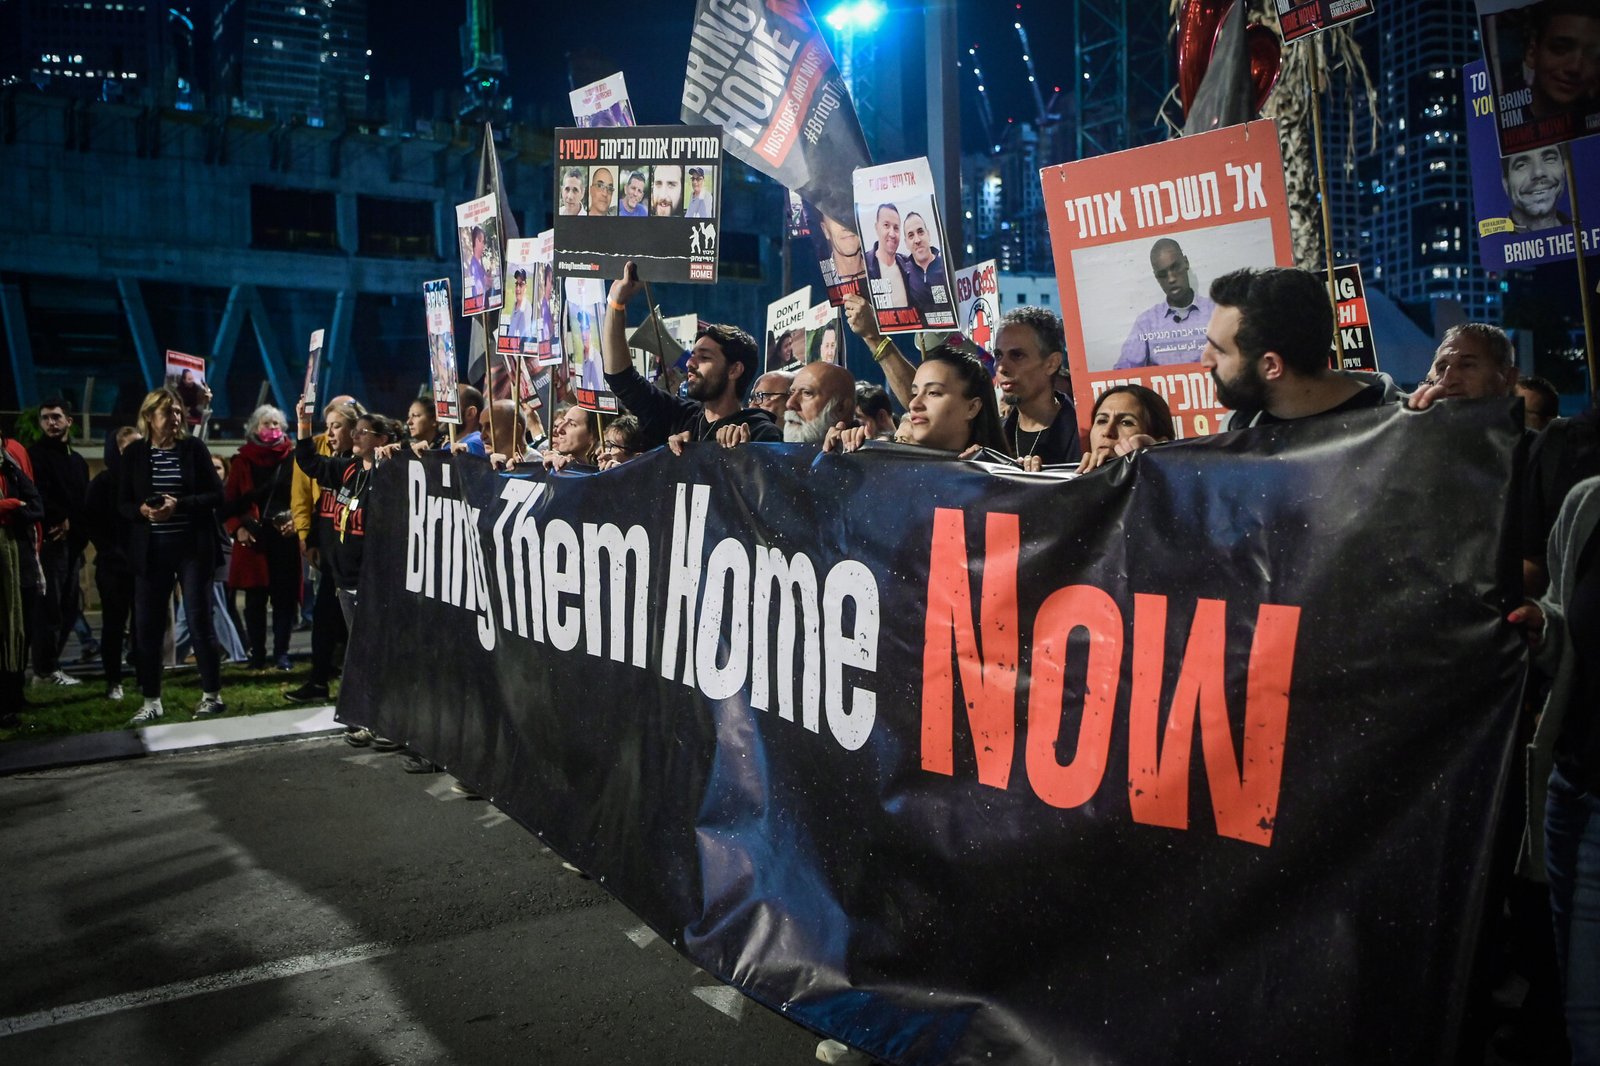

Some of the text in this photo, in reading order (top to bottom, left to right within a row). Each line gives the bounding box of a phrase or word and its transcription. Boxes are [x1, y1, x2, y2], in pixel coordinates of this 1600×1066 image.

[682, 0, 757, 114] BRING
[702, 17, 800, 148] HOME
[1470, 71, 1486, 93] TO
[763, 98, 800, 158] HOSTAGES
[791, 75, 810, 103] AND
[1499, 88, 1532, 112] BRING
[1501, 112, 1523, 129] HIM
[559, 137, 719, 160] מחזירים אותם הביתה עכשיו!
[1064, 162, 1267, 239] אל תשכחו אותי
[1504, 238, 1545, 264] BRING
[1546, 230, 1590, 256] THER
[690, 270, 713, 279] HOME!
[957, 266, 996, 303] RED CROSS
[776, 300, 801, 319] DON'T
[405, 459, 879, 751] Bring Them Home
